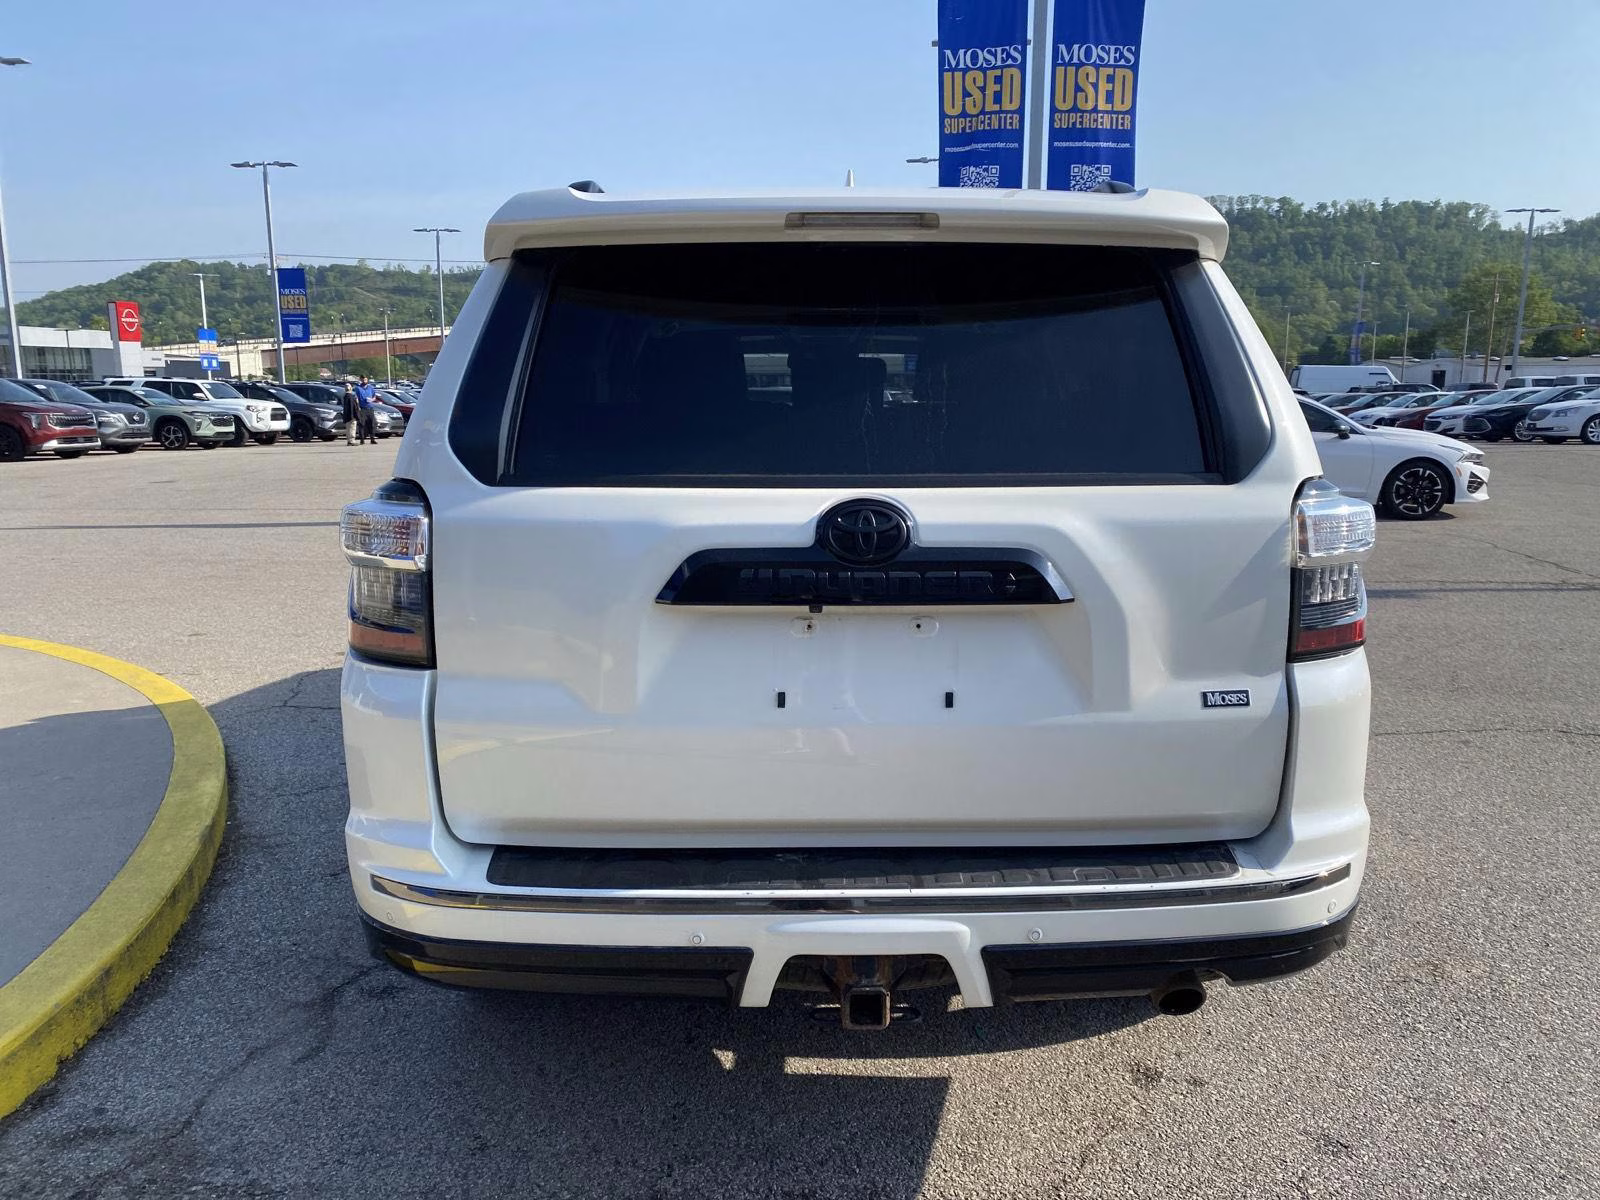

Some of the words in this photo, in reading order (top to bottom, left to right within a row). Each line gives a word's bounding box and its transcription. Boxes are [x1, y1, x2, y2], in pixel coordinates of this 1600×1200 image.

[944, 45, 1022, 69] MOSES
[1056, 43, 1136, 66] MOSES
[943, 67, 1022, 116] USED
[1054, 66, 1134, 111] USED
[944, 113, 1020, 134] SUPERCENTER
[1054, 112, 1131, 130] SUPERCENTER
[280, 295, 307, 309] USED
